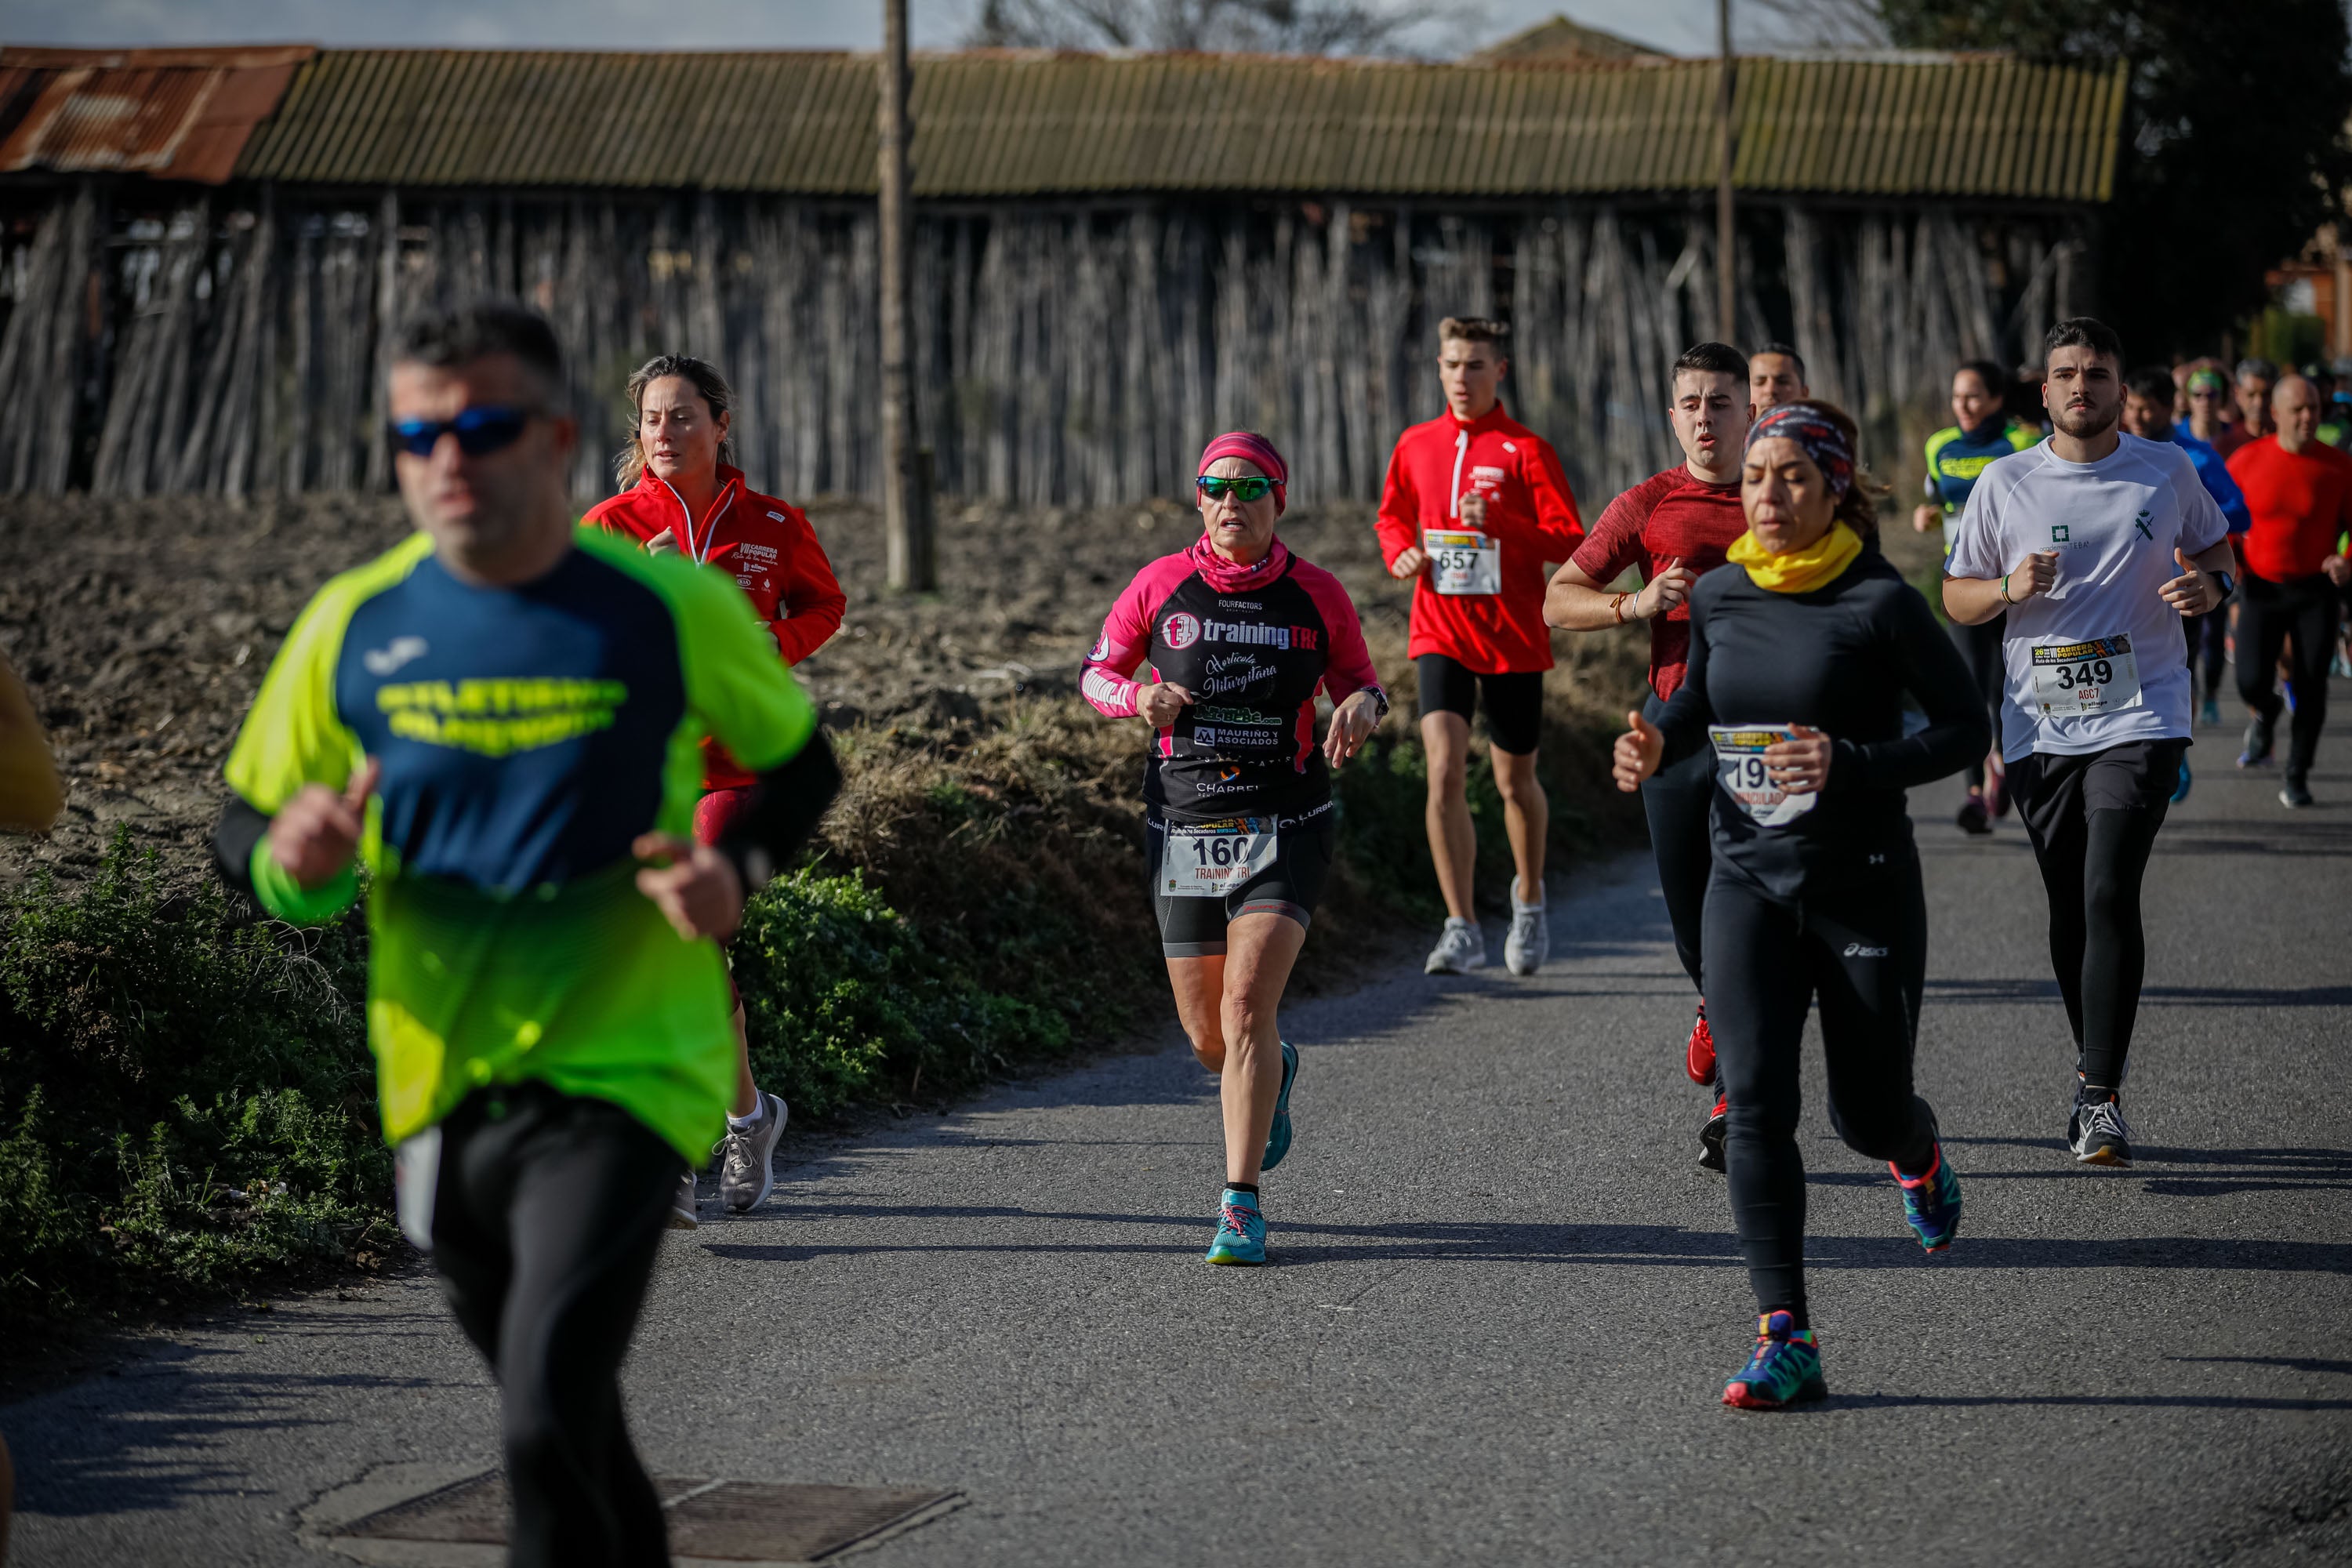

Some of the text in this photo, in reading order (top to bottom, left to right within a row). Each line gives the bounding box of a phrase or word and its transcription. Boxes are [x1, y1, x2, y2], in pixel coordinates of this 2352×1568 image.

[749, 549, 777, 559] POPULAR
[750, 544, 778, 554] CARRERA
[1440, 552, 1479, 569] 657
[1218, 599, 1262, 610] FOURFACTORS
[2056, 643, 2092, 653] CARRERA
[2057, 648, 2093, 658] POPULAR
[2056, 659, 2113, 690] 349
[2078, 688, 2100, 700] AGC7
[1218, 728, 1269, 738] MAURIÑO
[1217, 736, 1279, 746] ASOCIADOS
[1192, 837, 1250, 866] 160
[1195, 866, 1250, 879] TRAININ TRI
